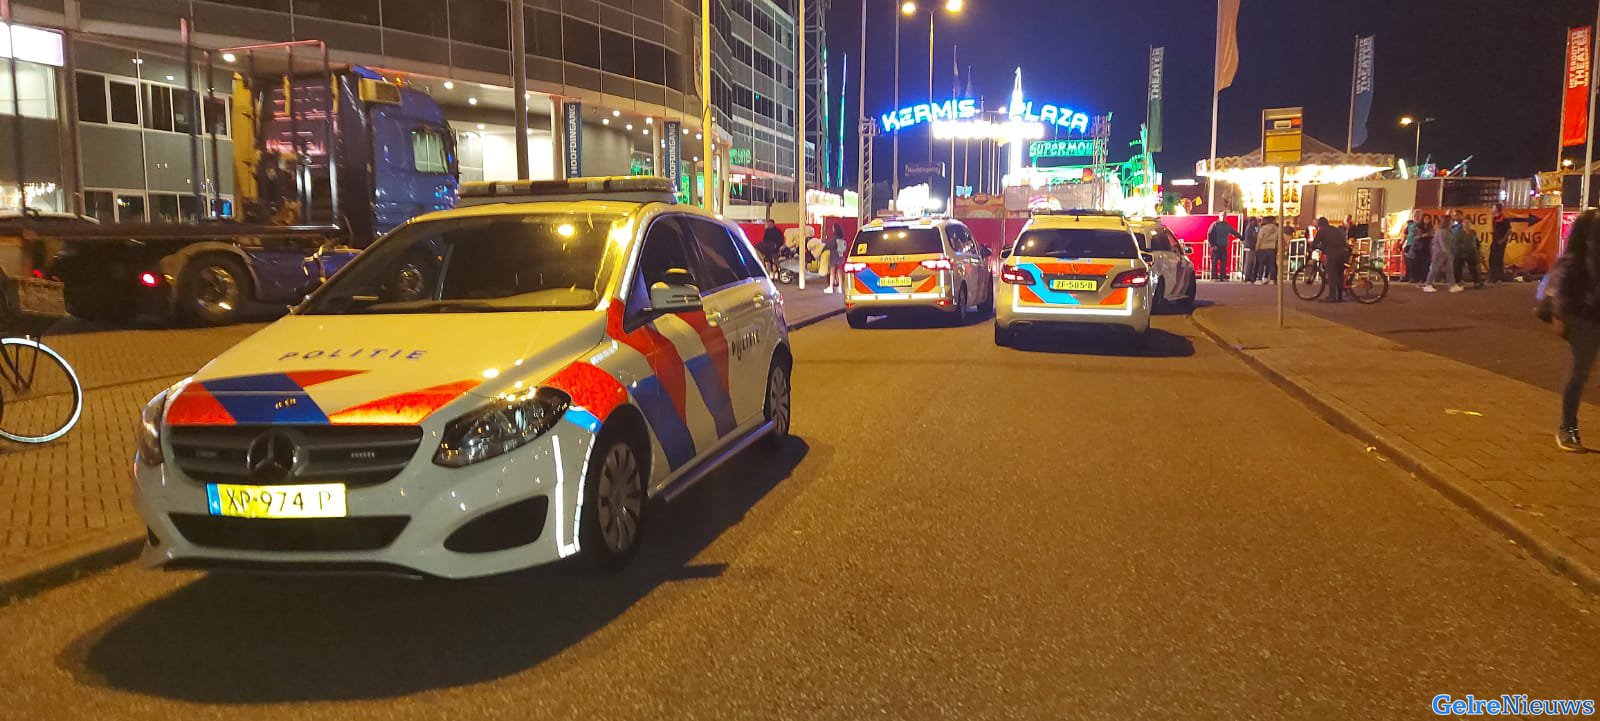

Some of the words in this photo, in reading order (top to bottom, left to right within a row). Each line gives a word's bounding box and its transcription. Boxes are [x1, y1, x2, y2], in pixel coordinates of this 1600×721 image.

[1575, 30, 1585, 85] THEATER
[882, 99, 977, 132] KERMIS
[1008, 100, 1089, 133] PLAZA
[568, 104, 578, 176] HOOFDINGANG
[277, 349, 427, 362] POLITIE
